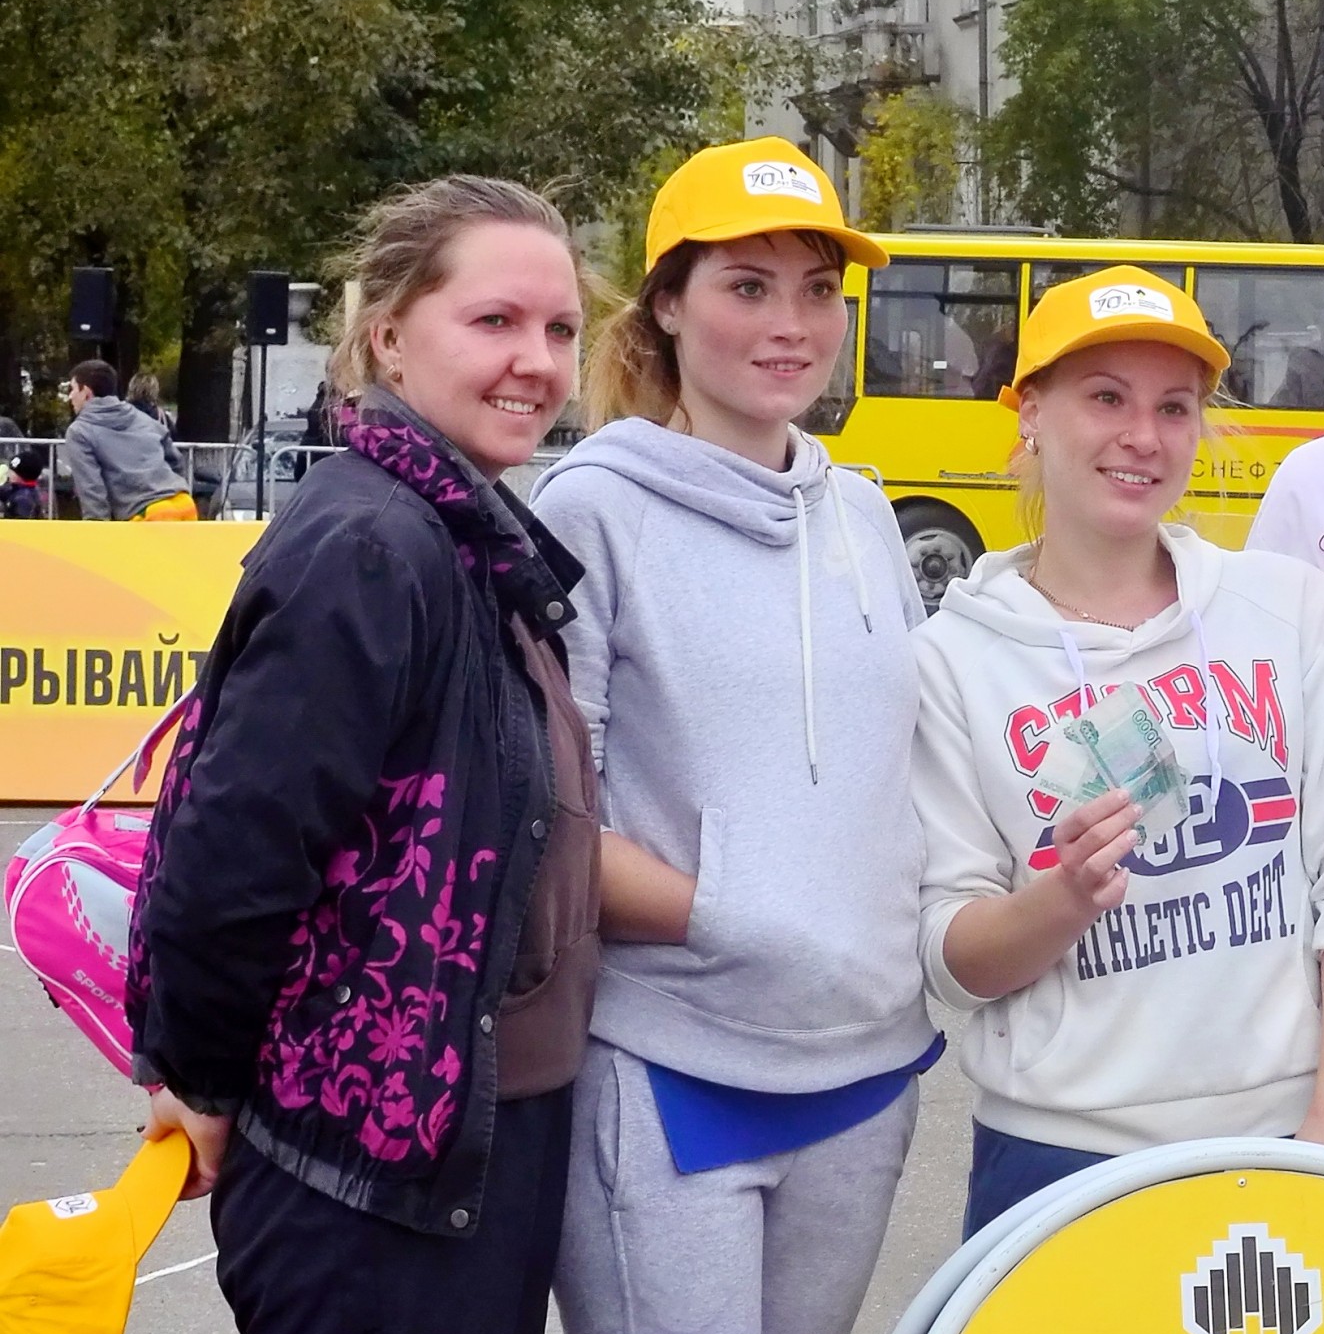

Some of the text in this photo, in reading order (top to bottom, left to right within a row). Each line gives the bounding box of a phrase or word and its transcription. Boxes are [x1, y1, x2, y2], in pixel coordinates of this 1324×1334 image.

[747, 172, 775, 187] 70
[1094, 295, 1121, 313] 70
[1191, 459, 1281, 479] СНЕФ
[1131, 709, 1162, 750] 1000
[1076, 850, 1295, 981] ATHLETIC DEPT.
